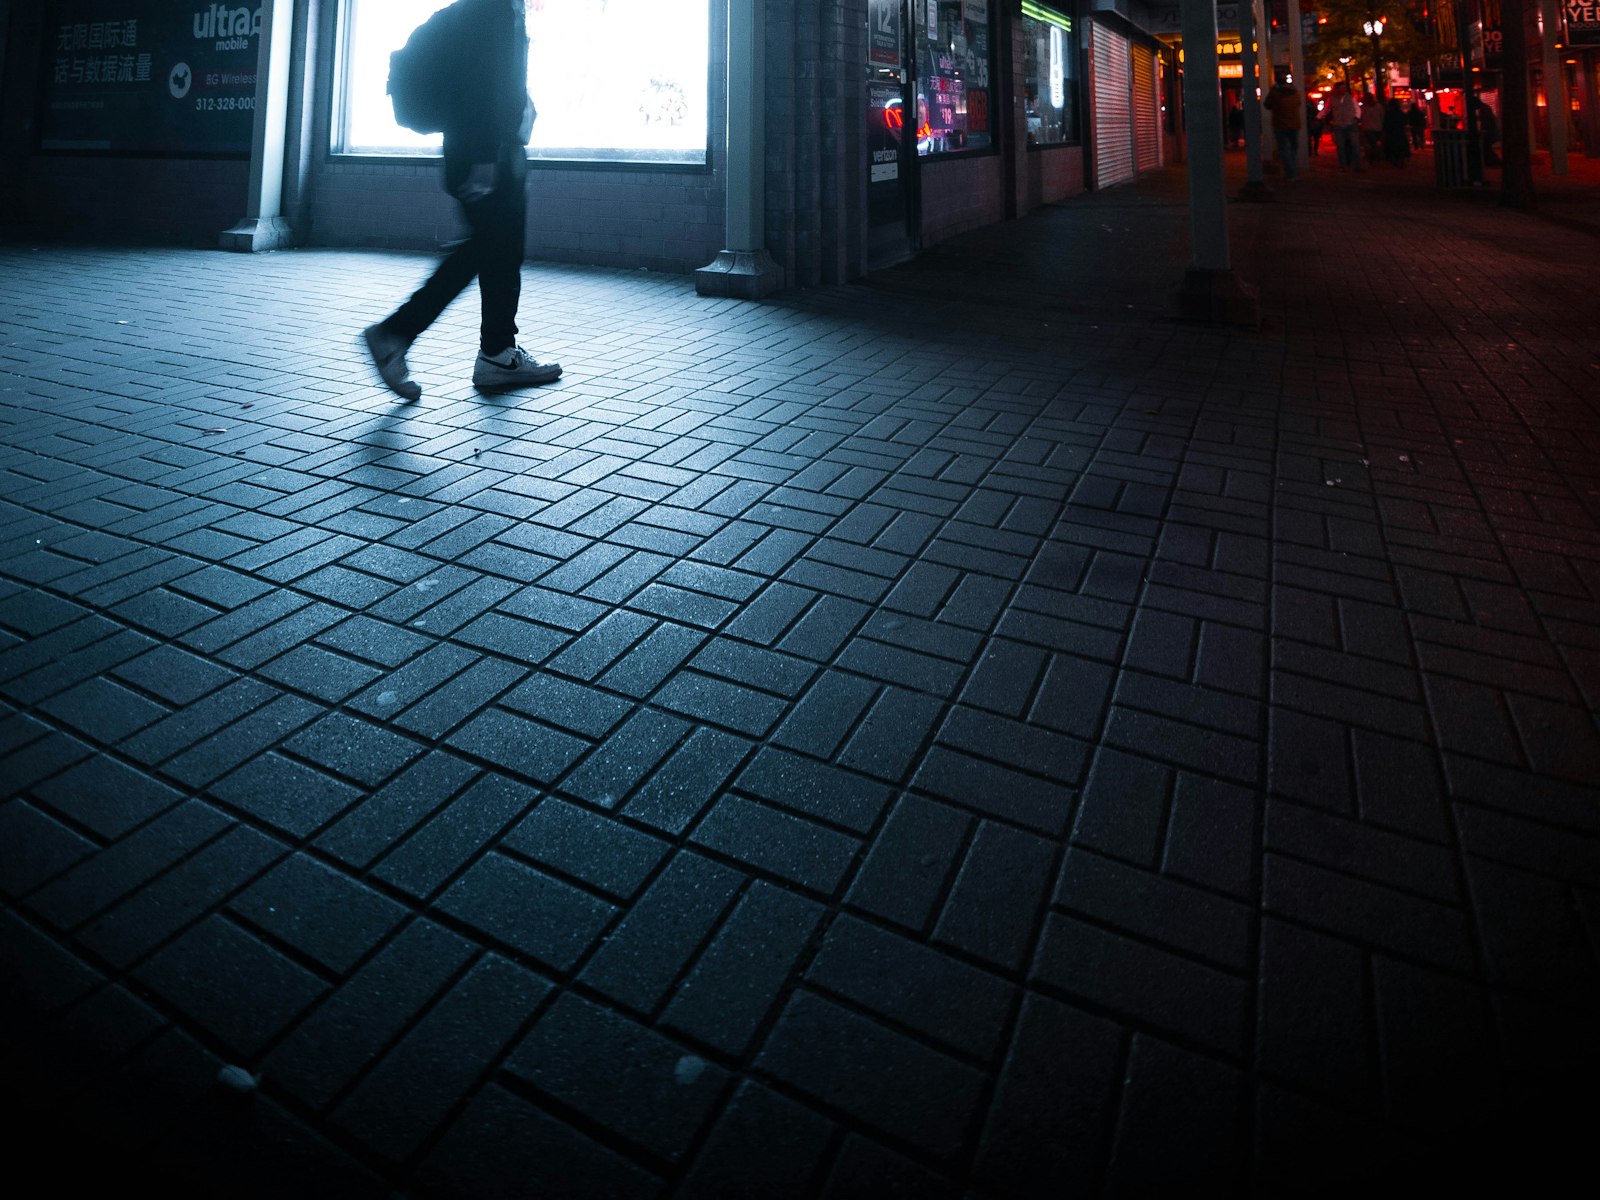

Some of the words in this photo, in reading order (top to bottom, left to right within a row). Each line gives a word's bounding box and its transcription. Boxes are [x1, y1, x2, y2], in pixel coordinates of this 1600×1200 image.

[57, 18, 137, 51] 无限国际通
[215, 37, 249, 51] mobile
[54, 52, 152, 84] 话与数据流量
[873, 147, 897, 163] verizon
